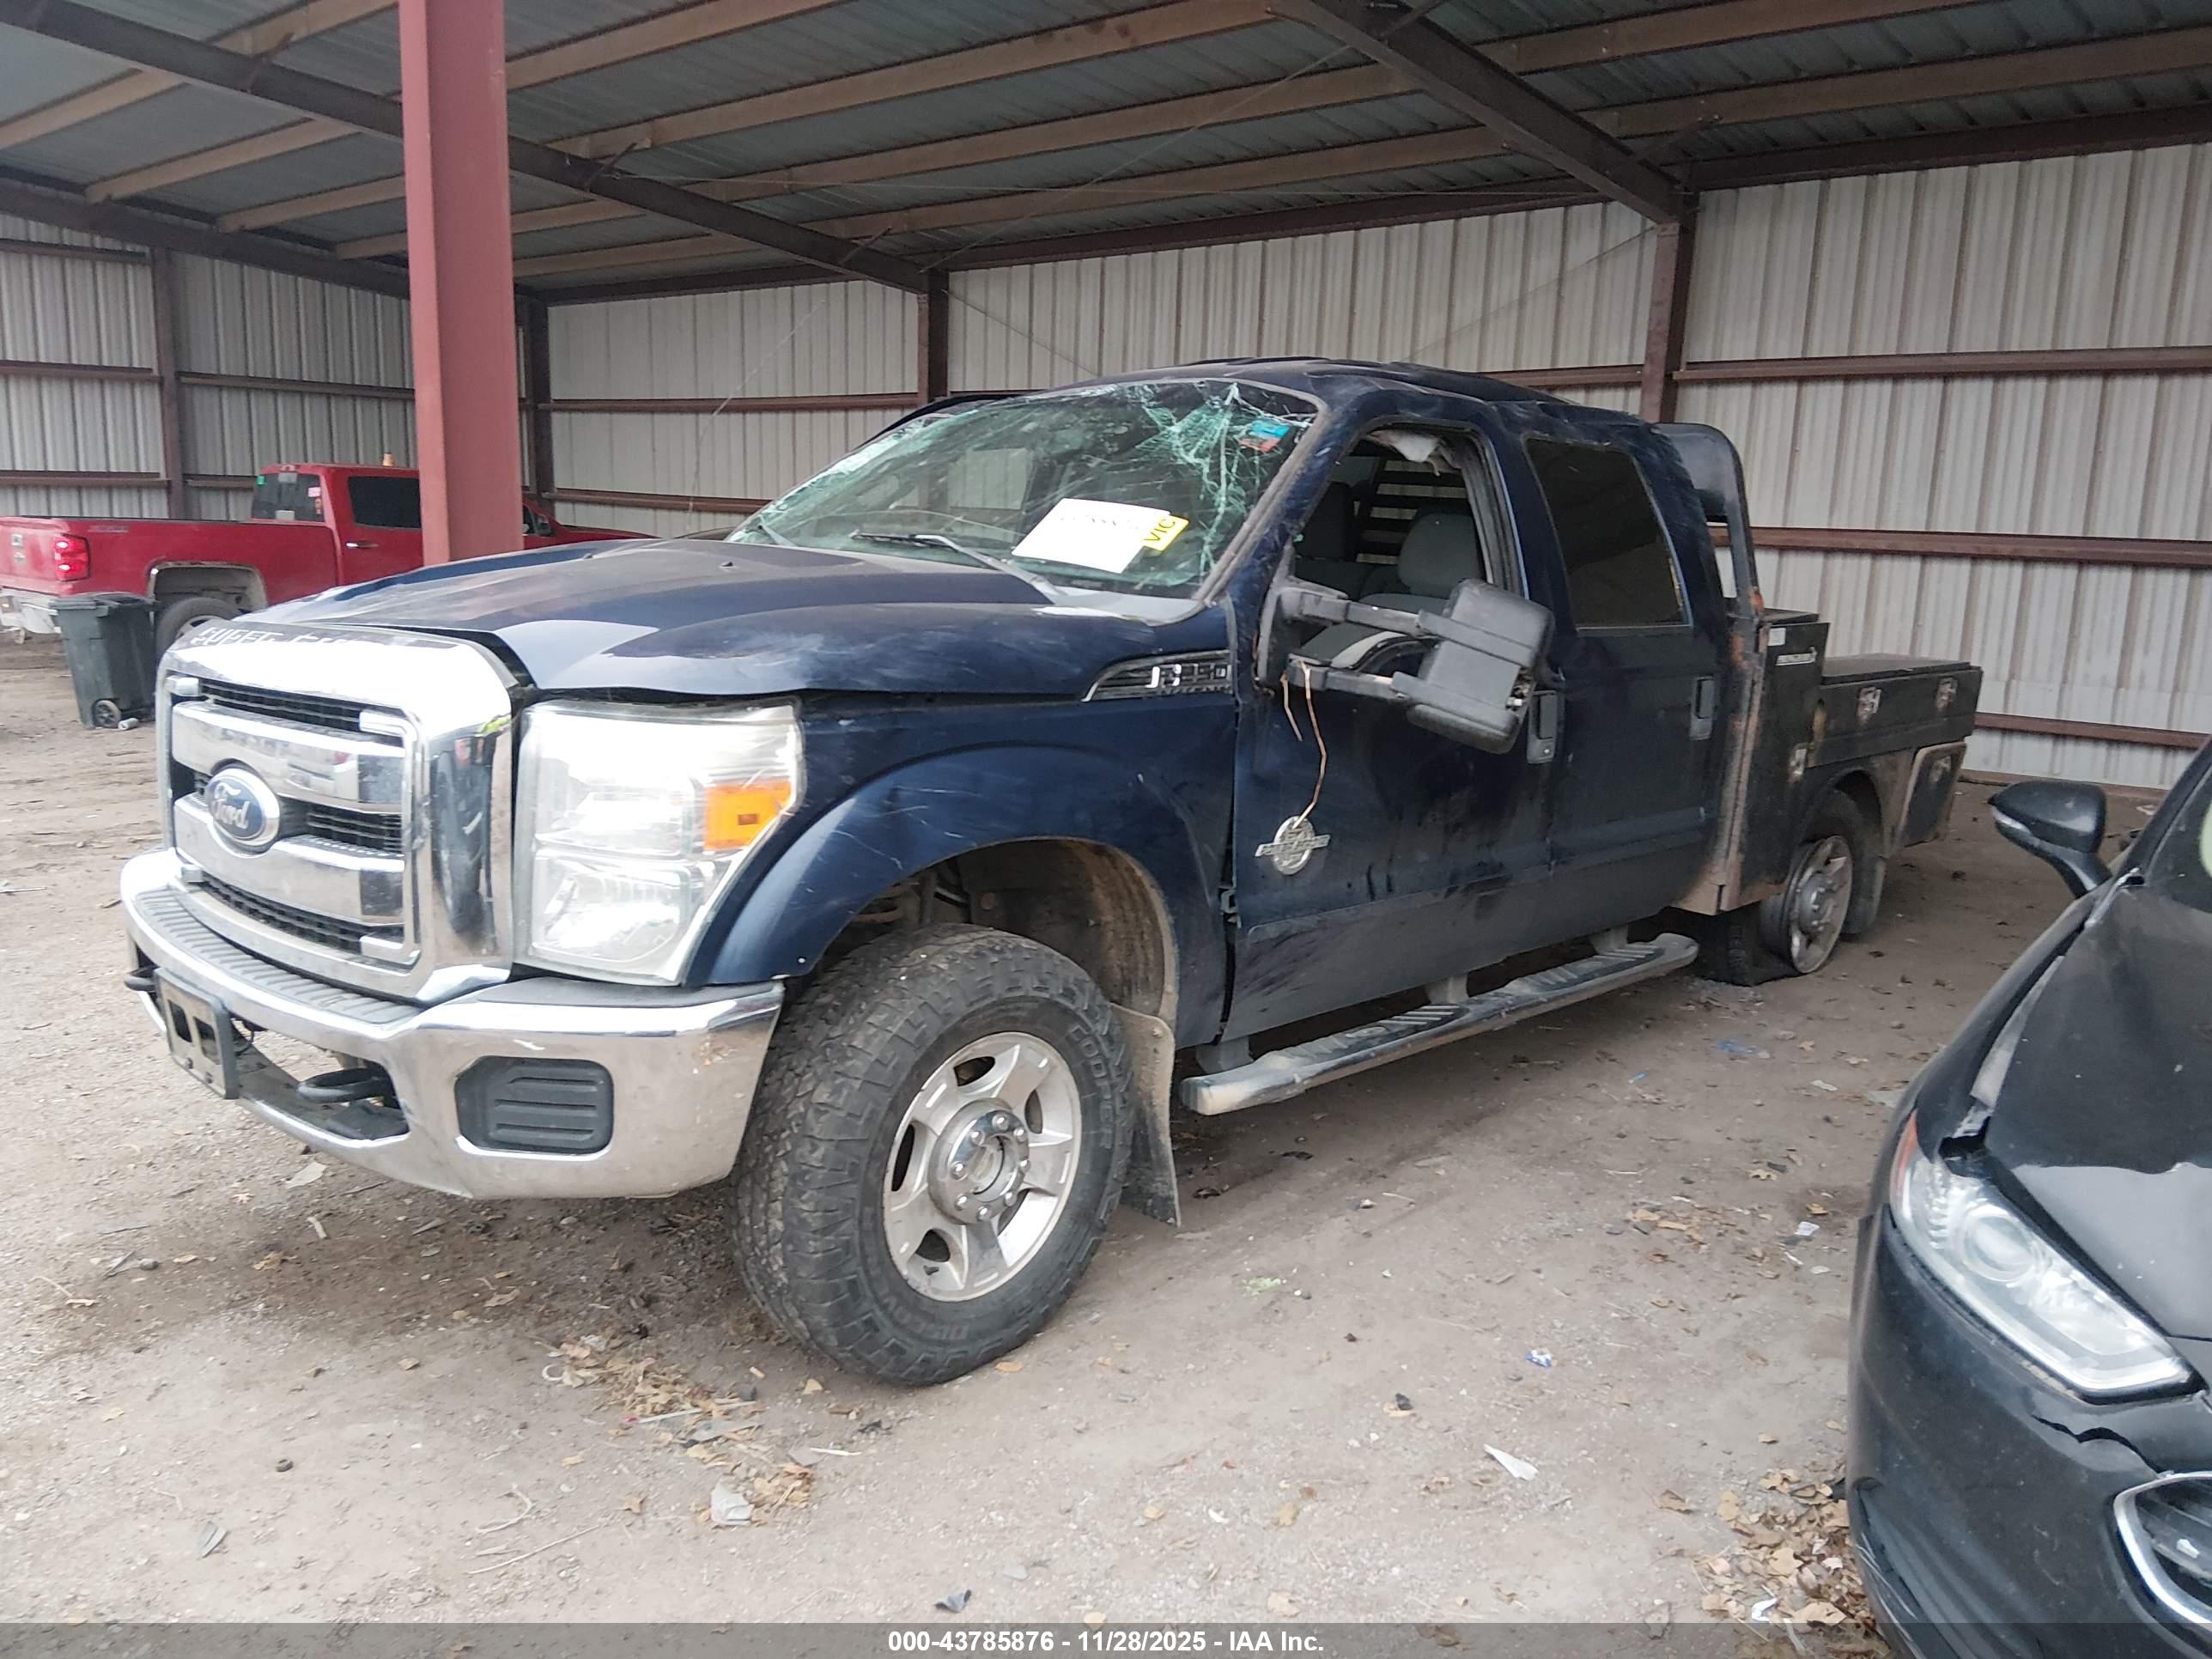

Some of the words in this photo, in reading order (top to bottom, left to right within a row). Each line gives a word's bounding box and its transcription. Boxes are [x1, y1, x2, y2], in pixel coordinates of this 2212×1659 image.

[1142, 518, 1176, 542] VIC
[210, 781, 251, 830] Ford
[1068, 1024, 1114, 1150] COOPER
